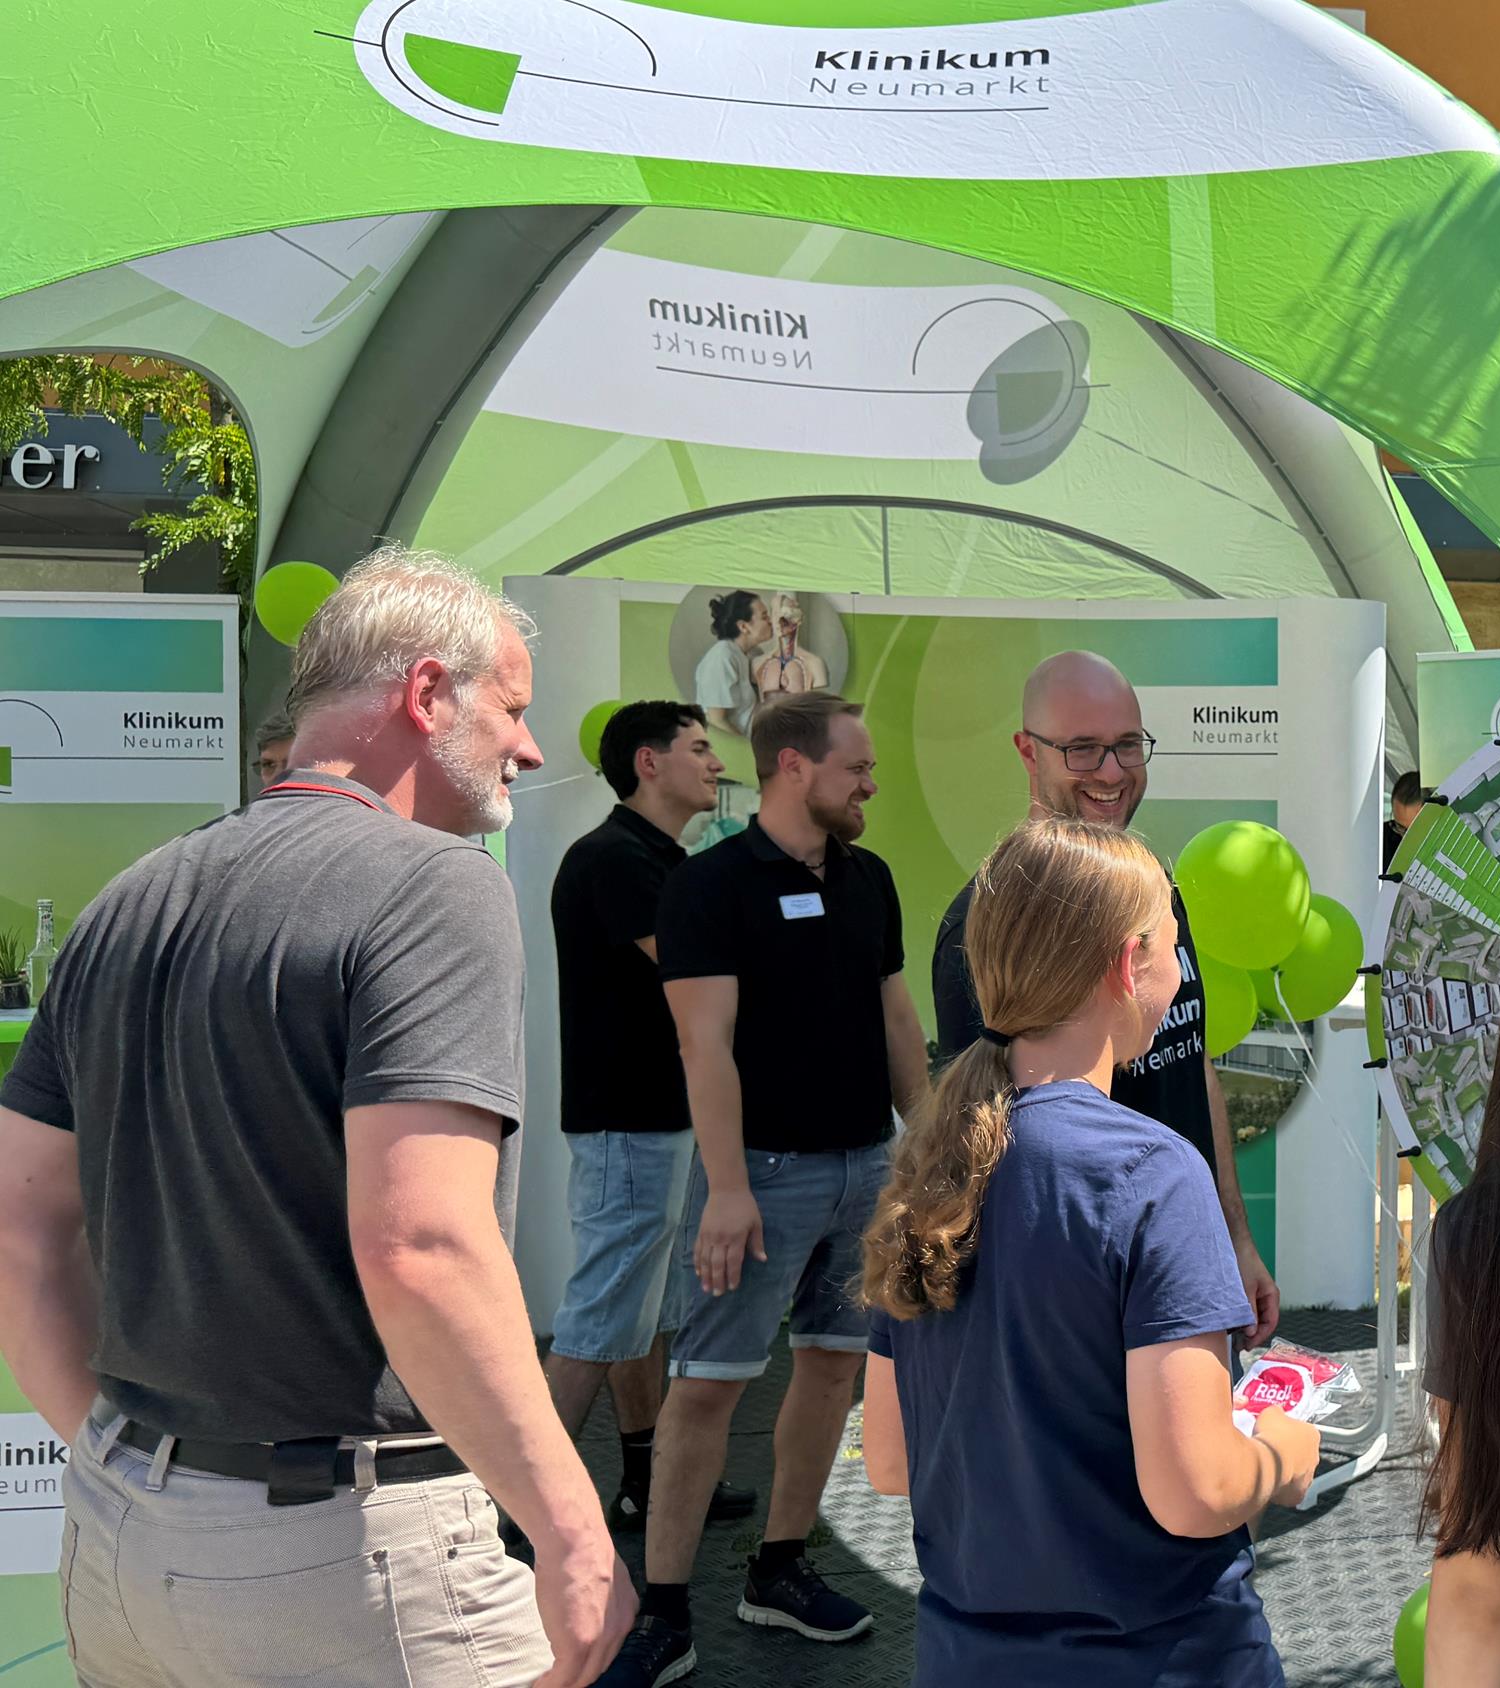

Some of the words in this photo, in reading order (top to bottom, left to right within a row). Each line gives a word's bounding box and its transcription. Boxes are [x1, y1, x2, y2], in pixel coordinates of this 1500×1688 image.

[815, 49, 1050, 70] Klinikum
[809, 76, 1050, 96] Neumarkt
[124, 712, 223, 729] Klinikum
[1193, 706, 1278, 724] Klinikum
[124, 735, 223, 749] Neumarkt
[1193, 730, 1278, 743] Neumarkt
